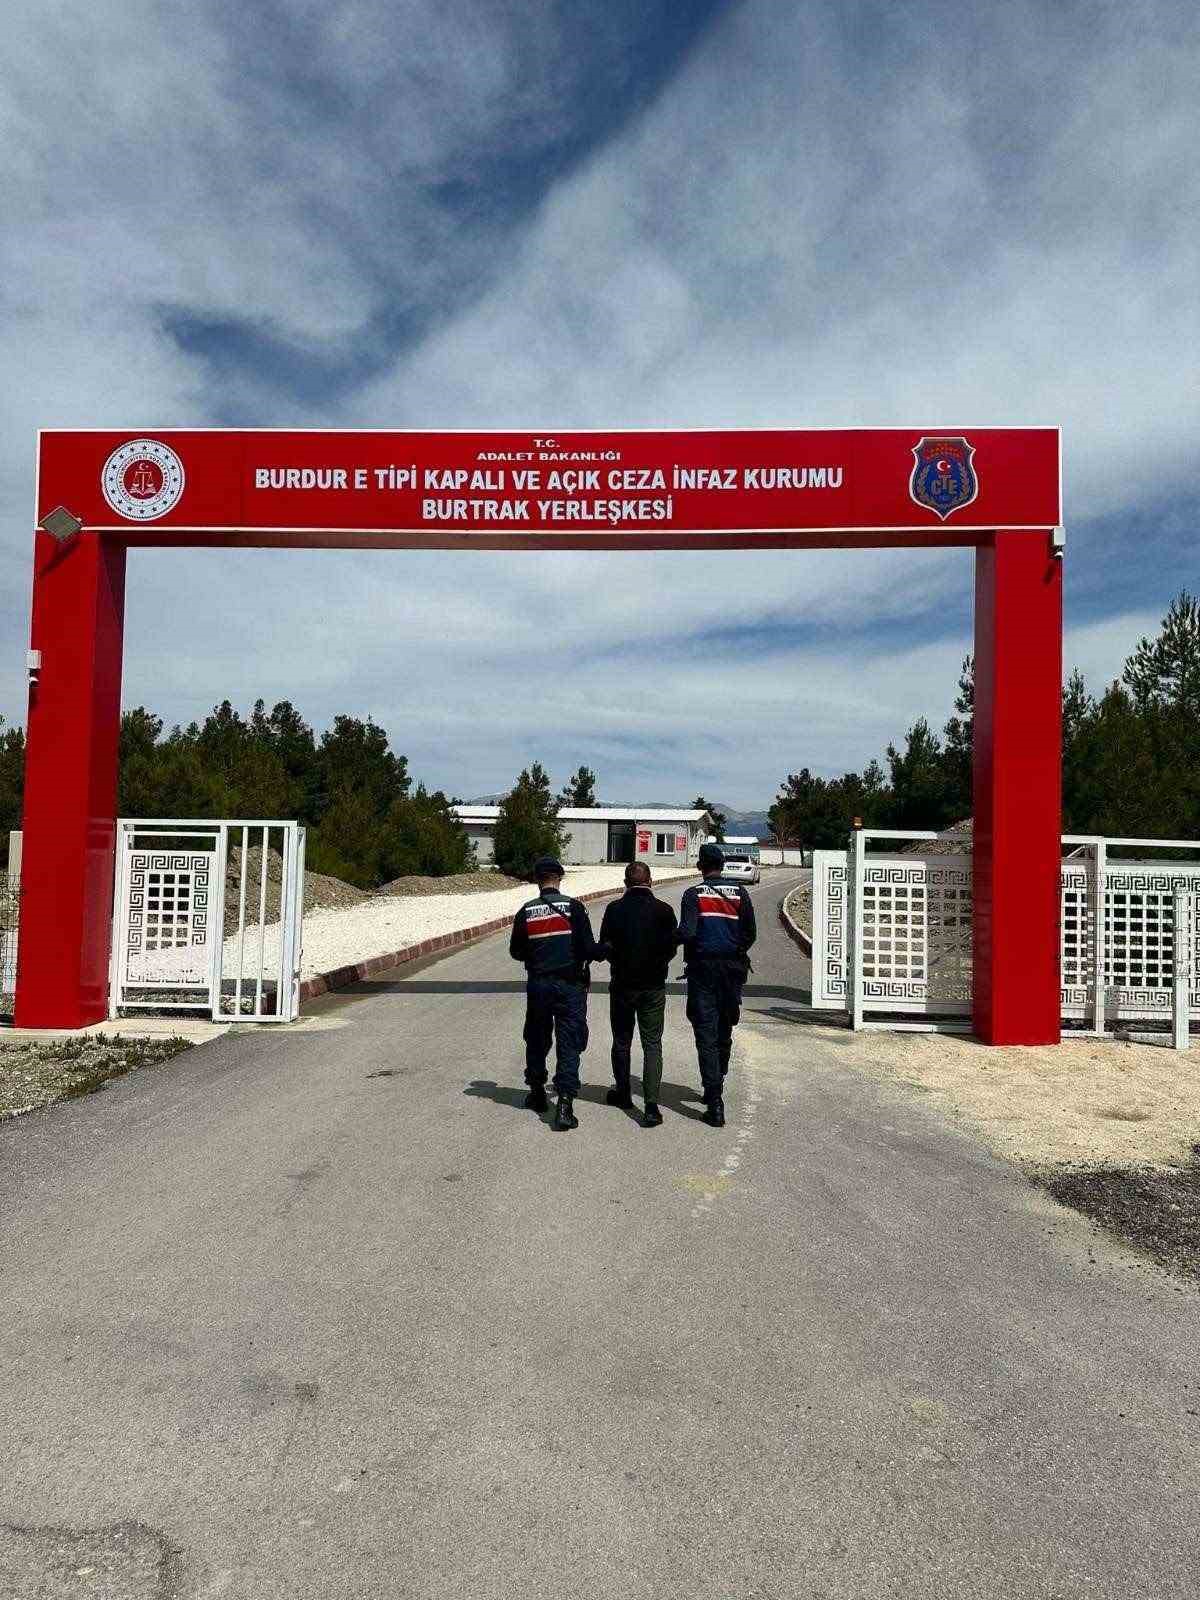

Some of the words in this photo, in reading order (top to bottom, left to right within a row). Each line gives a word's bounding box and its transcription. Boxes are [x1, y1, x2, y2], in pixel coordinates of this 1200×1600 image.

[534, 439, 560, 447] T.C.
[539, 451, 620, 461] BAKANLIĞI
[256, 469, 347, 489] BURDUR
[355, 469, 367, 489] E
[374, 465, 416, 489] TİPİ
[425, 470, 504, 490] KAPALI
[512, 471, 540, 490] VE
[547, 471, 600, 495] AÇIK
[608, 470, 666, 490] CEZA
[674, 464, 737, 489] İNFAZ
[744, 468, 842, 489] KURUMU
[423, 499, 529, 520] BURTRAK
[537, 494, 672, 525] YERLEŞKESİ
